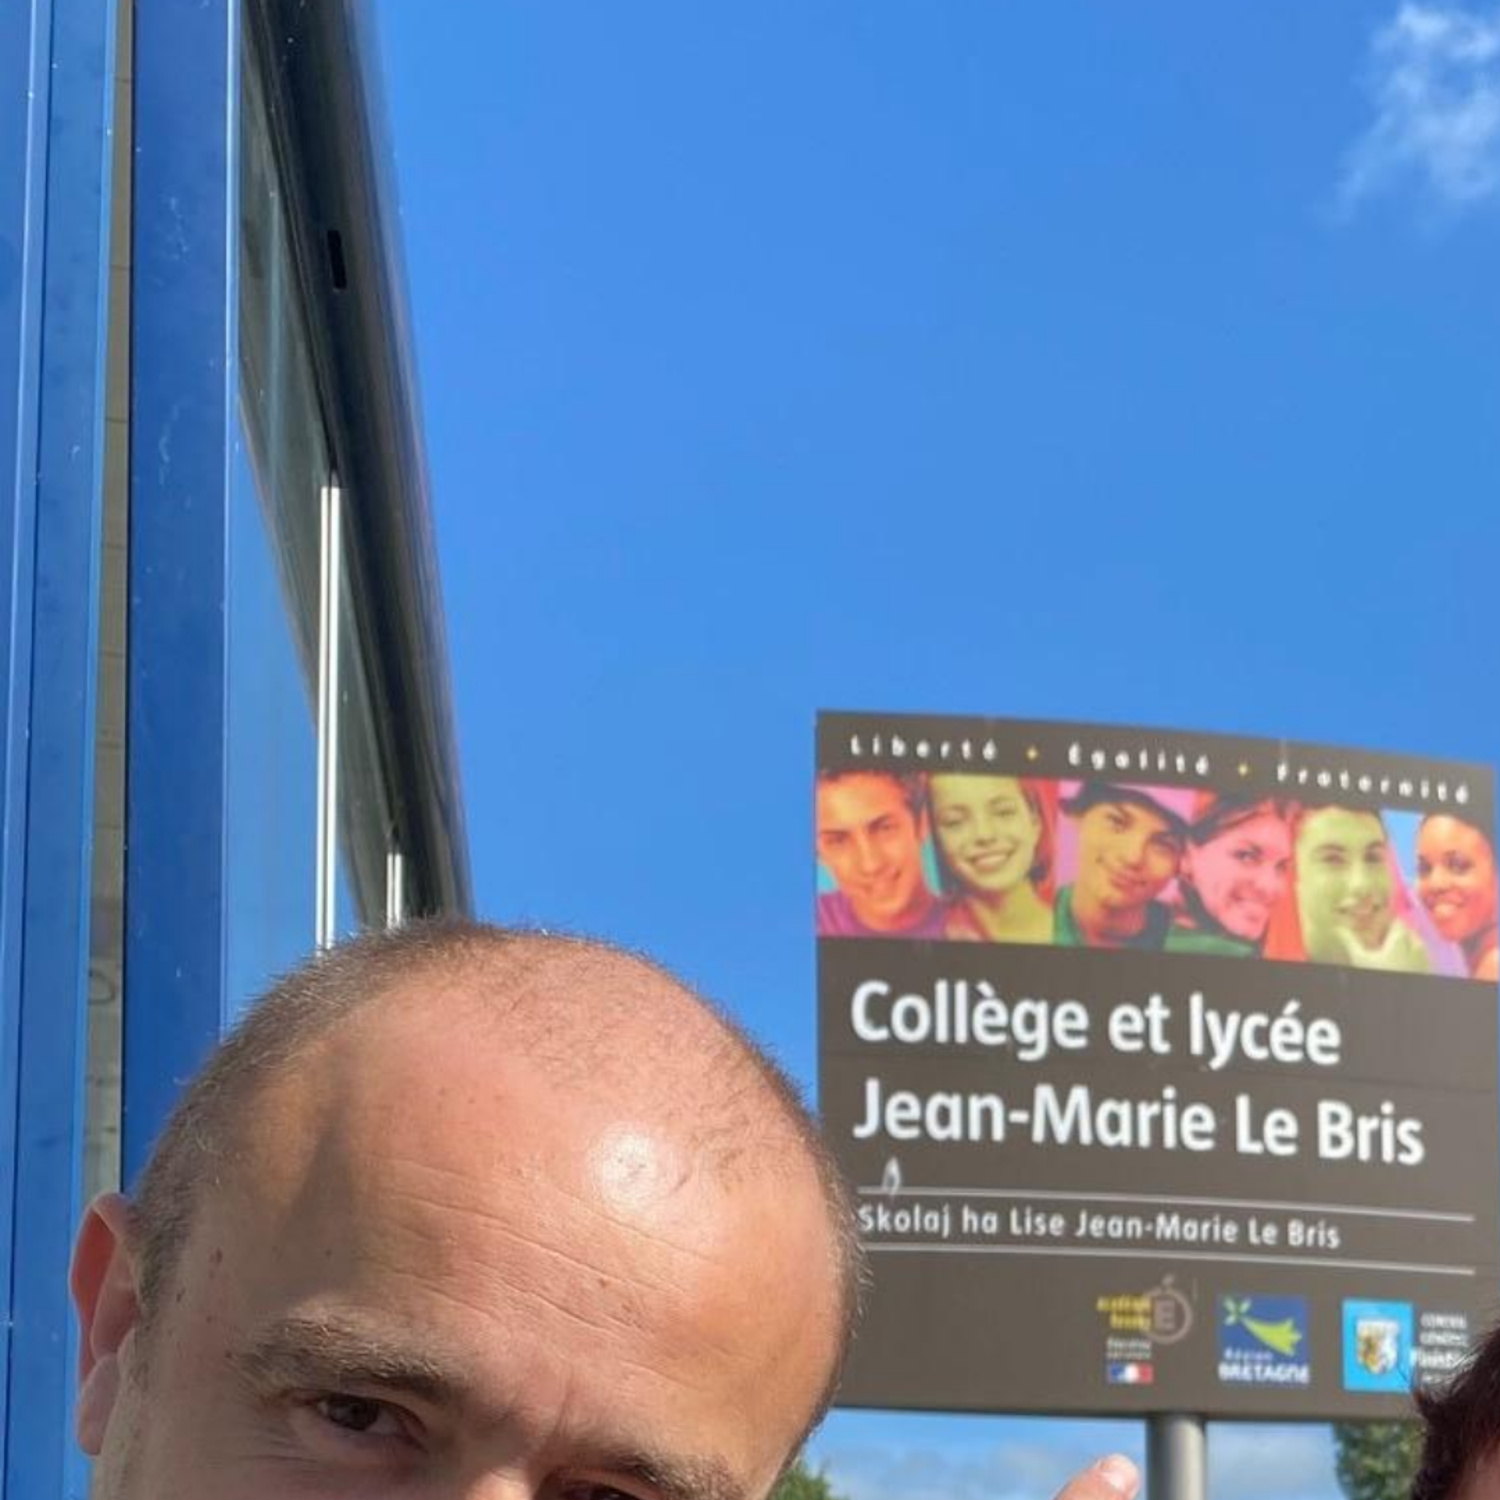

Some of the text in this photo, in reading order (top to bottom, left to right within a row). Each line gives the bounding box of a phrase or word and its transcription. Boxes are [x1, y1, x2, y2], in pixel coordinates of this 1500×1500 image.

[850, 734, 999, 762] Liberté
[1276, 761, 1470, 806] Fraternité
[850, 979, 1342, 1070] Collège et lycée
[852, 1078, 1426, 1166] Jean-Marie Le Bris
[858, 1203, 1342, 1250] Skolaj ha Lise Jean-Marie Le Bris
